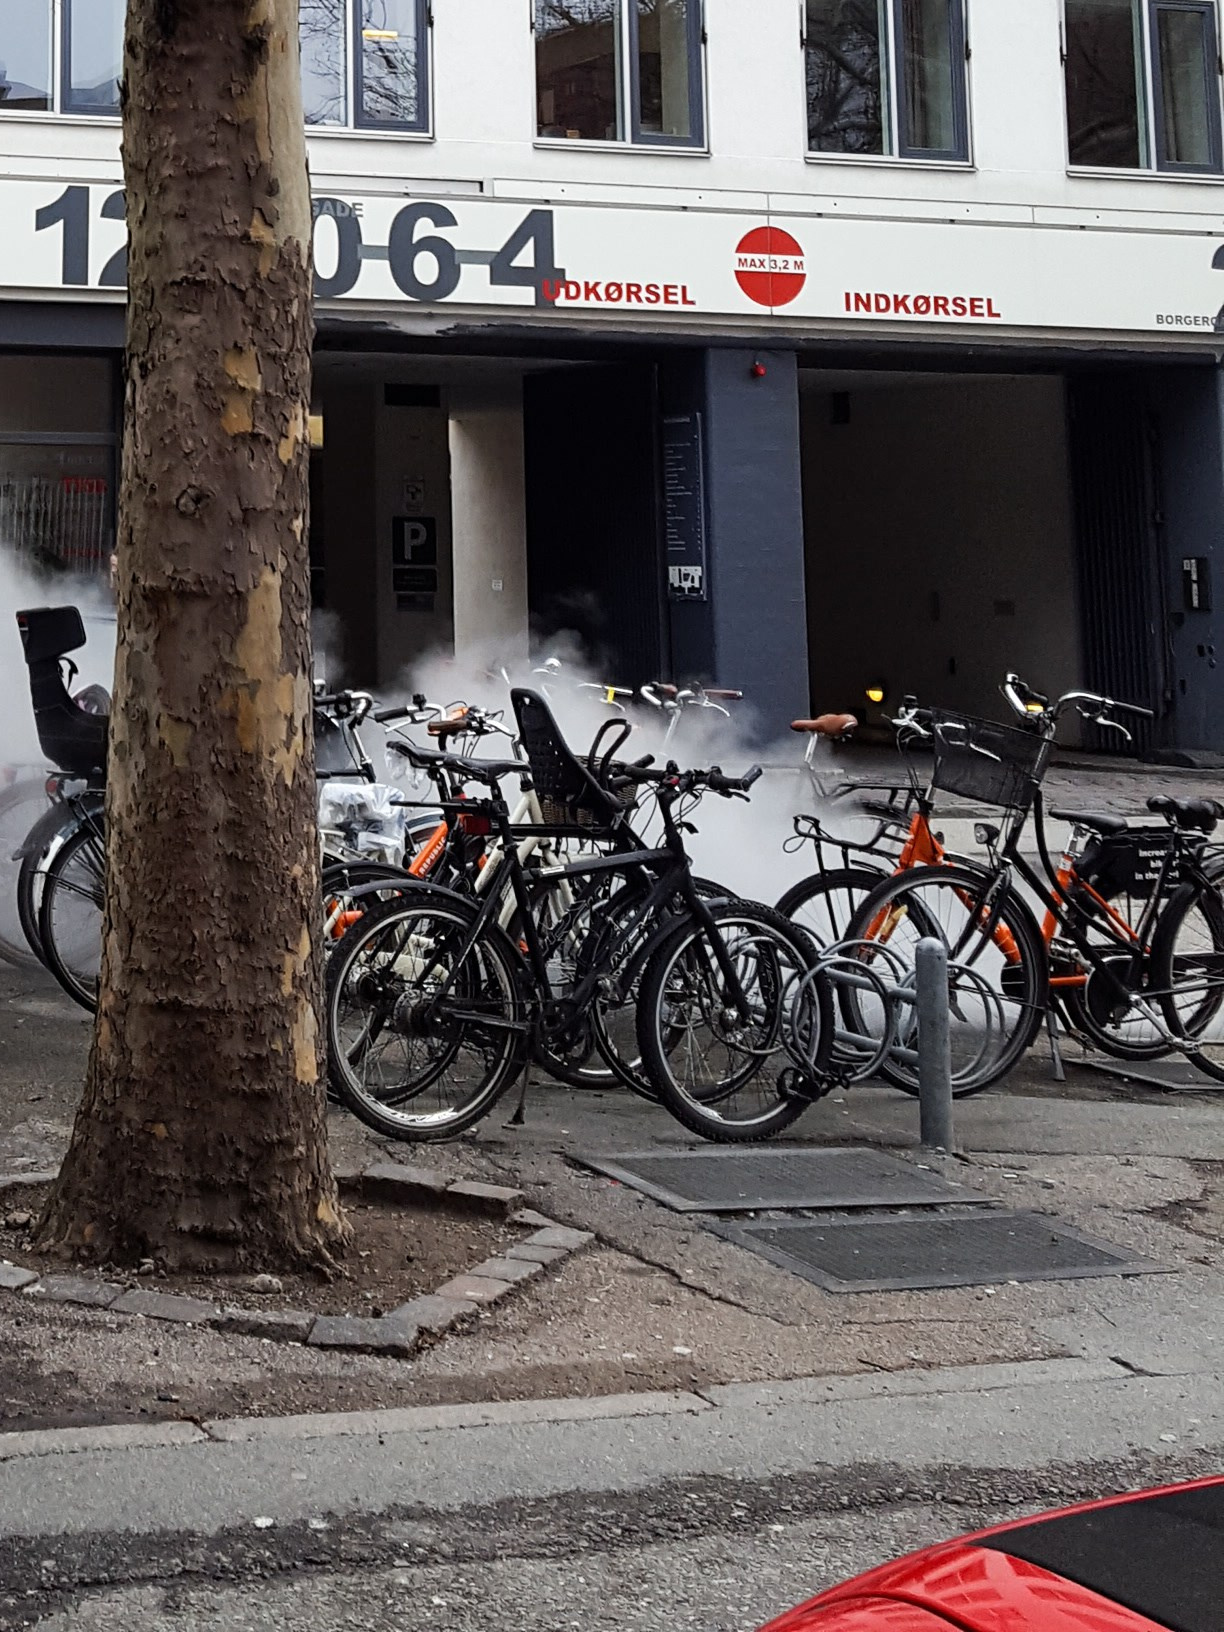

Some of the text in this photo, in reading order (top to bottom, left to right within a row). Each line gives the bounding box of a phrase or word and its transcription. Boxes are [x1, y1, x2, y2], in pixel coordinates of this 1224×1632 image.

[737, 257, 805, 272] MAX 3,2 M
[541, 279, 697, 306] UDKØRSEL
[844, 291, 1002, 319] INDKØRSEL
[403, 521, 428, 562] P
